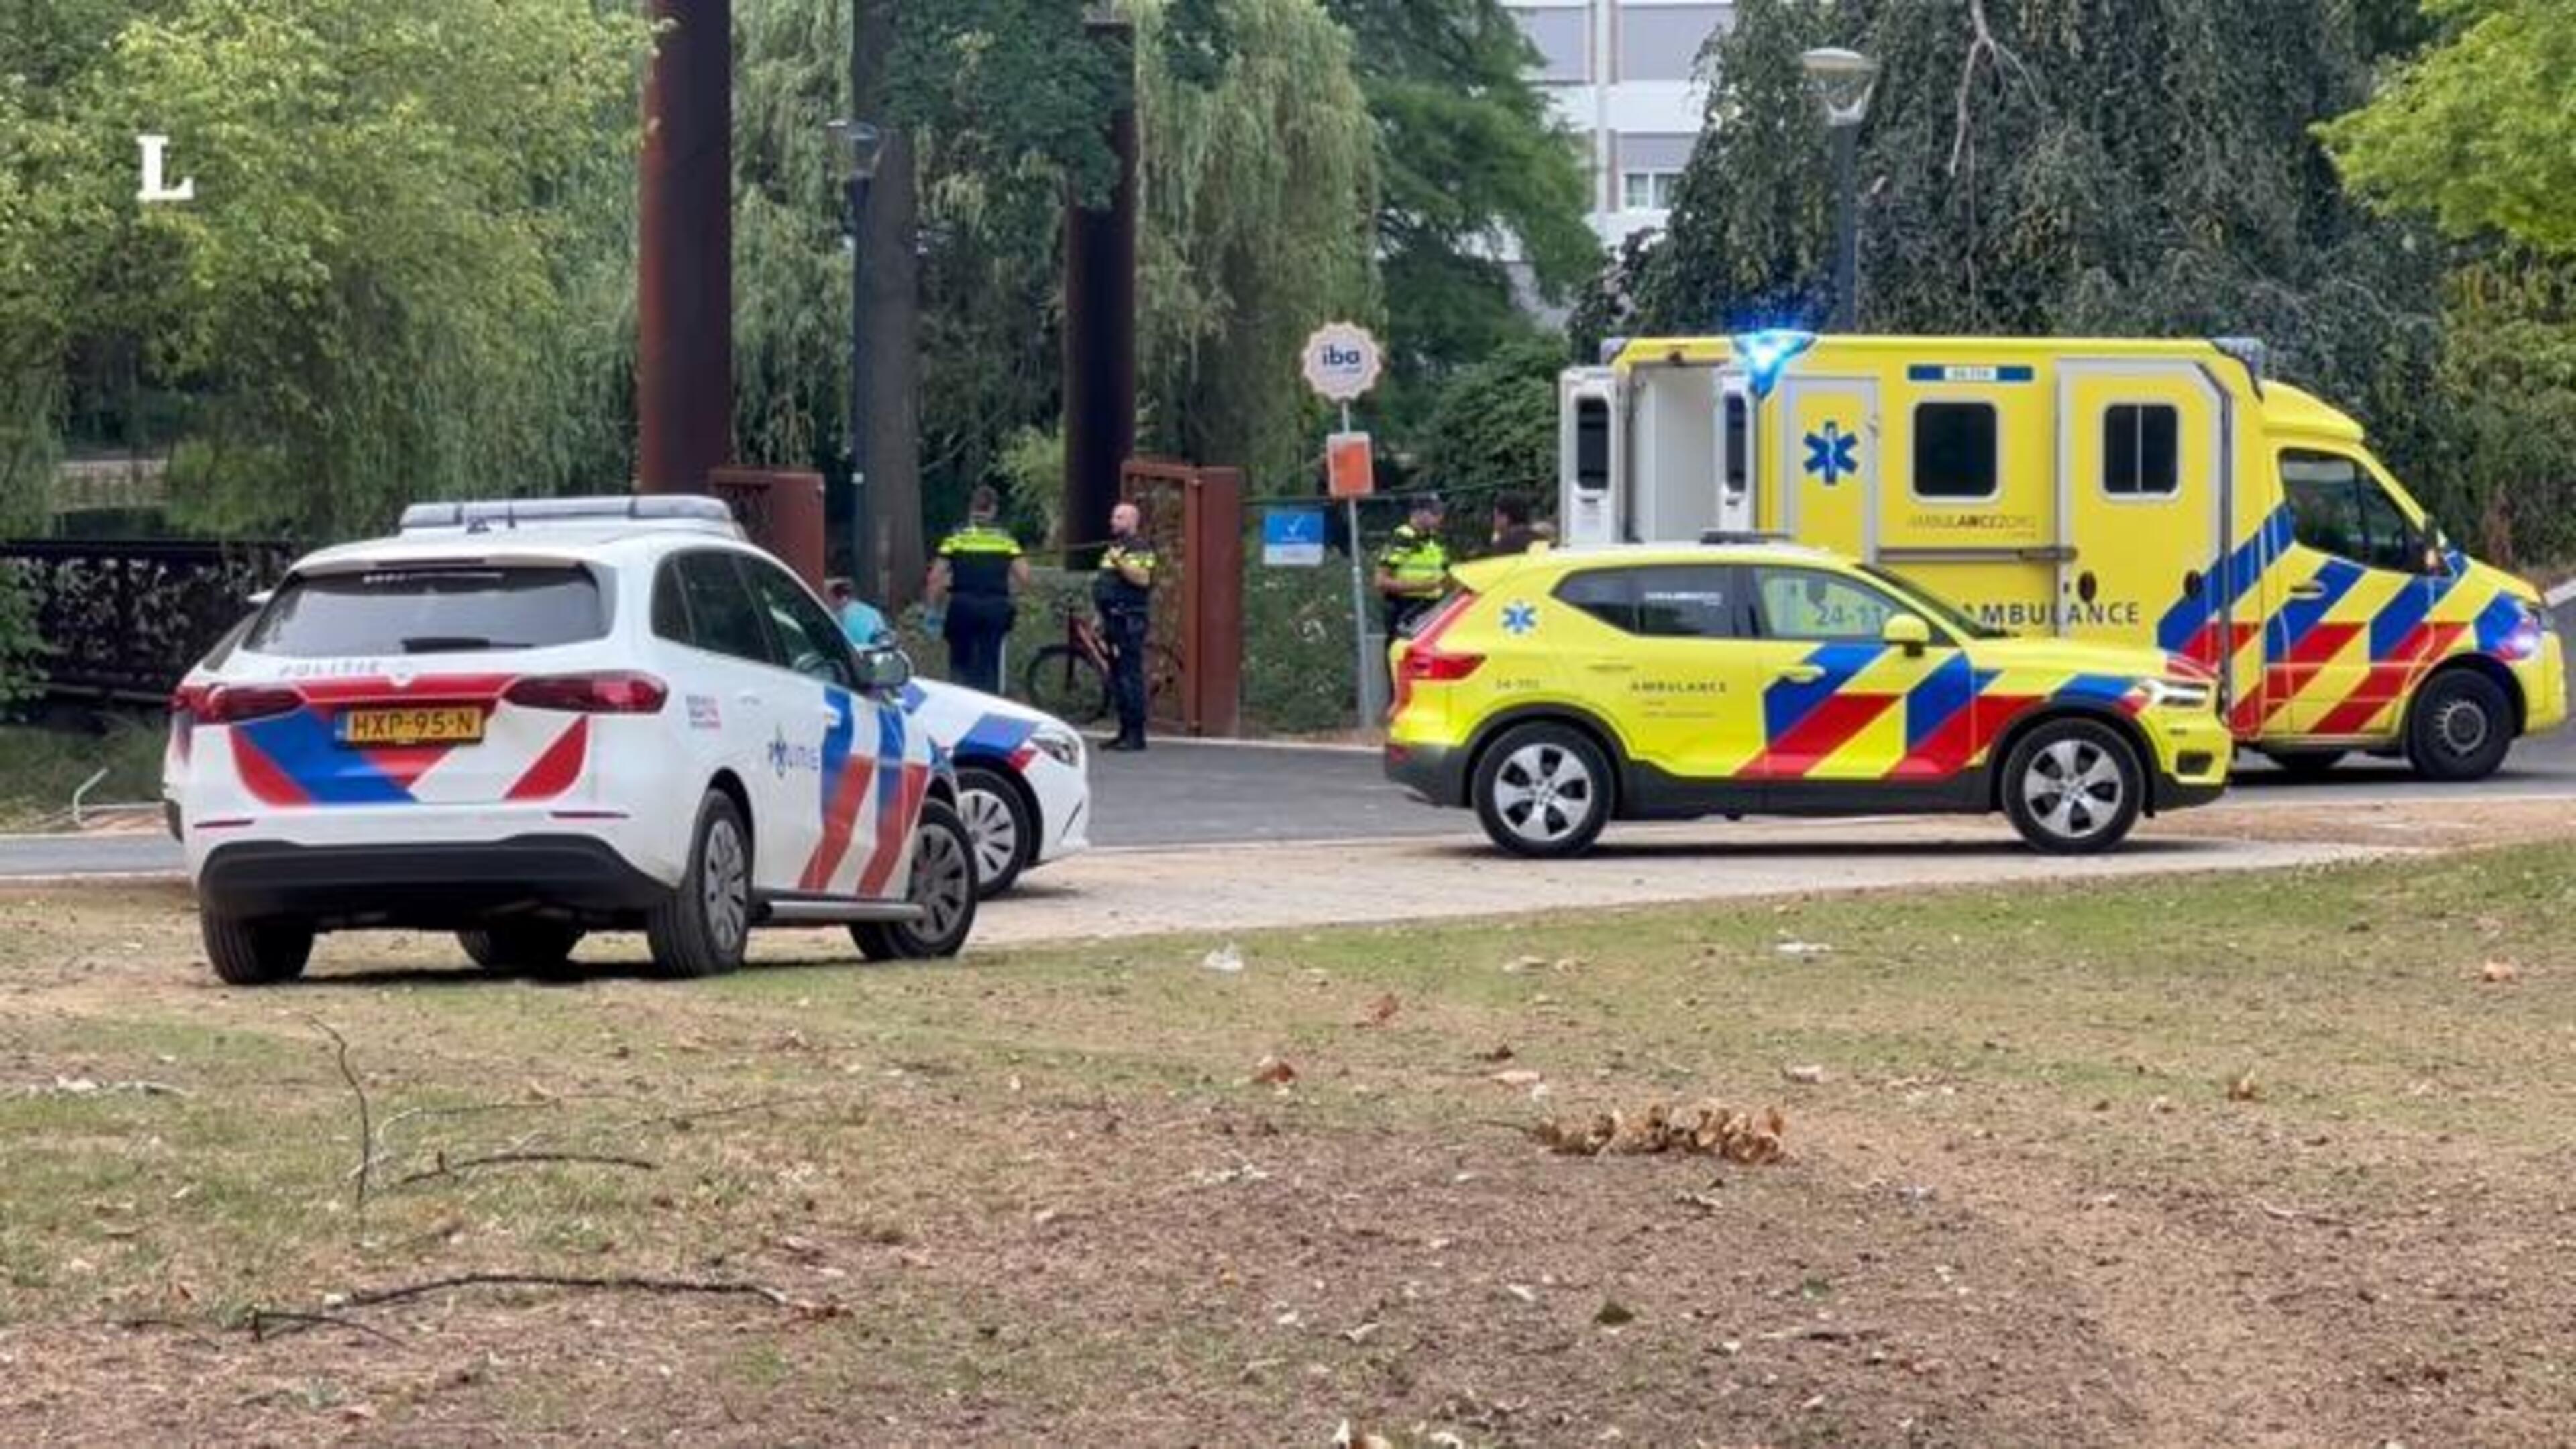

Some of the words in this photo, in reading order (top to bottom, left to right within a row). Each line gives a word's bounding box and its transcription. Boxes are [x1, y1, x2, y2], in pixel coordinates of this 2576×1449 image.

[1322, 344, 1360, 366] iba
[1630, 681, 1727, 693] AMBULANCE
[353, 711, 474, 741] HXP-95-N
